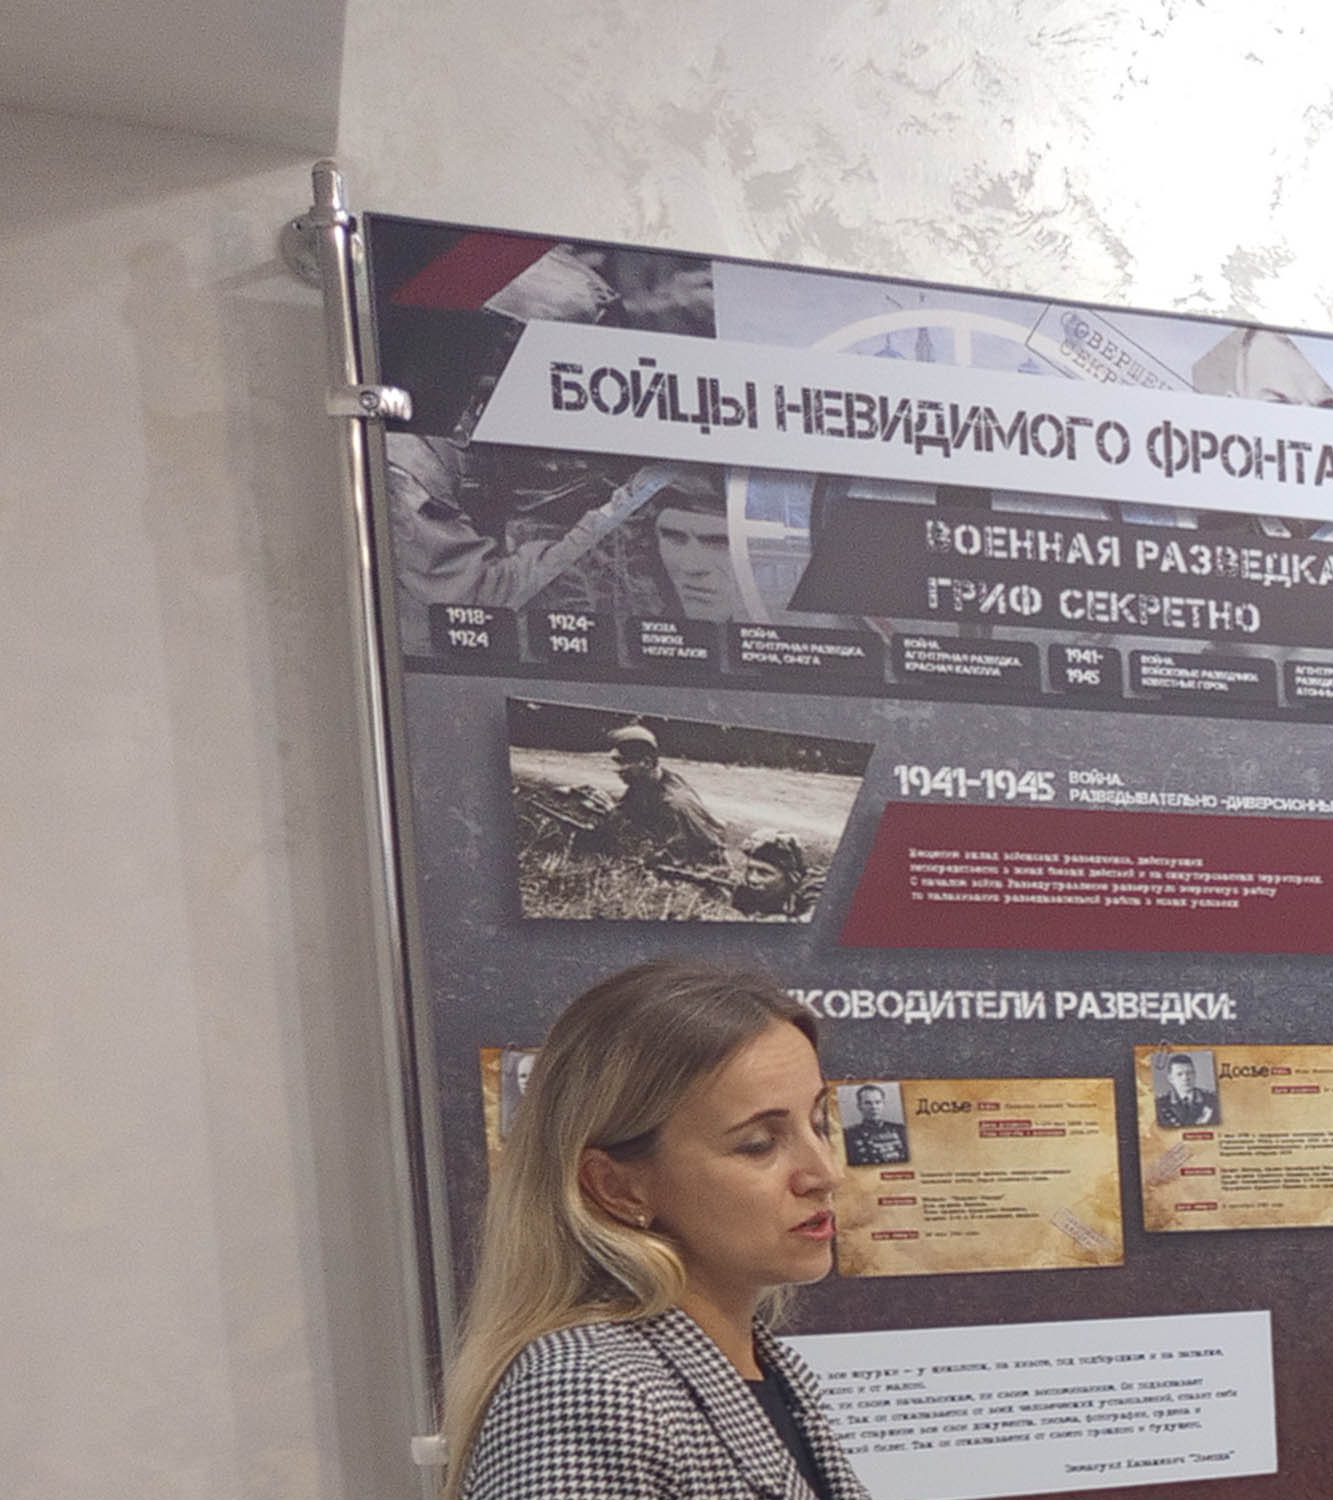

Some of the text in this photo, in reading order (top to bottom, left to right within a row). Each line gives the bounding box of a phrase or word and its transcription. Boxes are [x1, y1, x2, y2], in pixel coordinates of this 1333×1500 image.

[550, 357, 757, 434] БОЙЦЫ
[774, 385, 1130, 465] НЕВИДИМОГО
[926, 520, 1121, 567] ВОЕННАЯ
[928, 577, 1260, 632] ГРИФ СЕКРЕТНО
[446, 607, 493, 625] 1918-
[548, 613, 595, 632] 1924-
[448, 630, 490, 648] 1924
[549, 635, 590, 654] 1941
[894, 765, 1056, 800] 1941-1945
[1056, 990, 1237, 1024] РАЗВЕДКИ:
[1219, 1063, 1269, 1080] Досье
[916, 1098, 972, 1116] Досье
